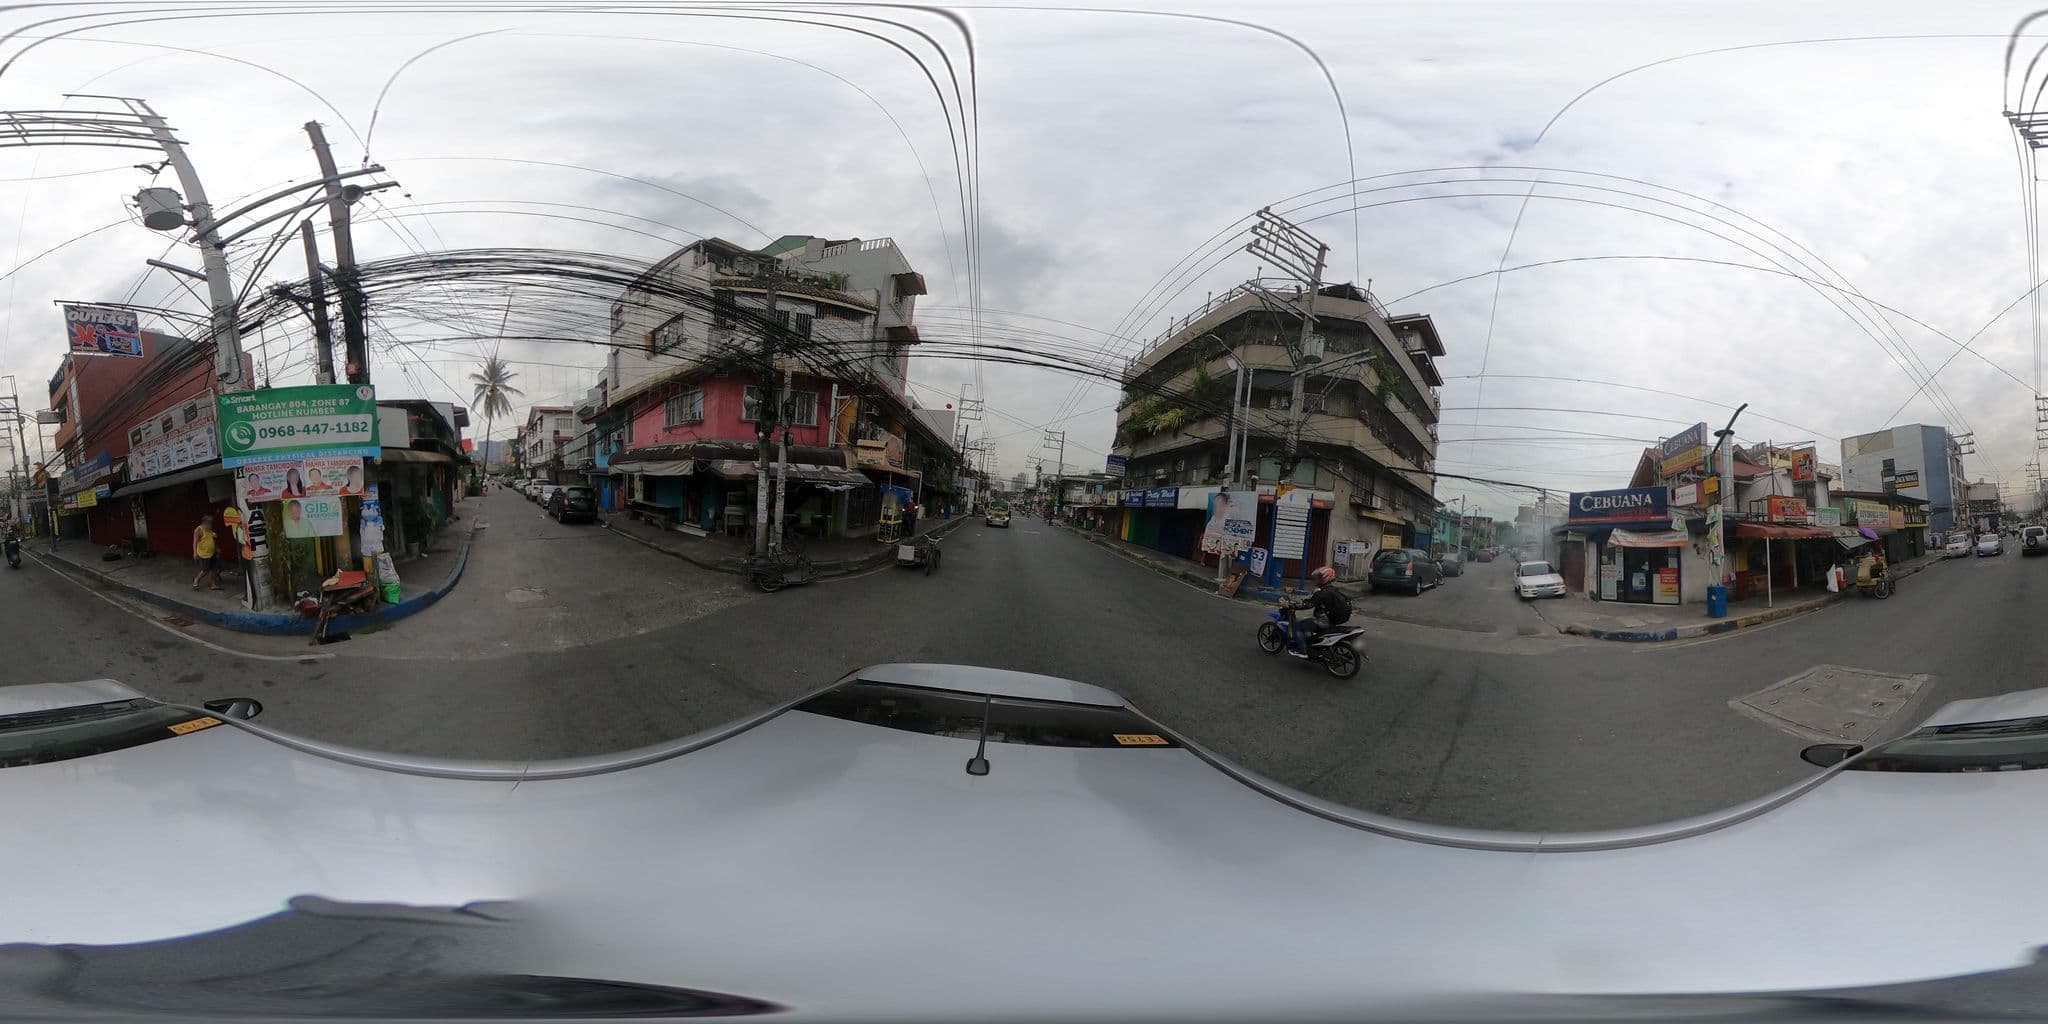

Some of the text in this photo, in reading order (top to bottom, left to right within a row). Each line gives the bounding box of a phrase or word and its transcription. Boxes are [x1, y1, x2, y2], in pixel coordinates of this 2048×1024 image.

[67, 310, 136, 326] OUTLAST
[230, 394, 256, 404] Smart
[236, 401, 287, 413] BARANGAY
[311, 399, 337, 407] ZONE
[252, 407, 336, 420] HOTLINE NUMBER
[258, 421, 369, 439] 0968-447-1182
[1663, 430, 1699, 456] CEBUANA
[1579, 493, 1653, 512] CEBUANA
[1252, 550, 1265, 561] 53
[1337, 545, 1347, 554] 53
